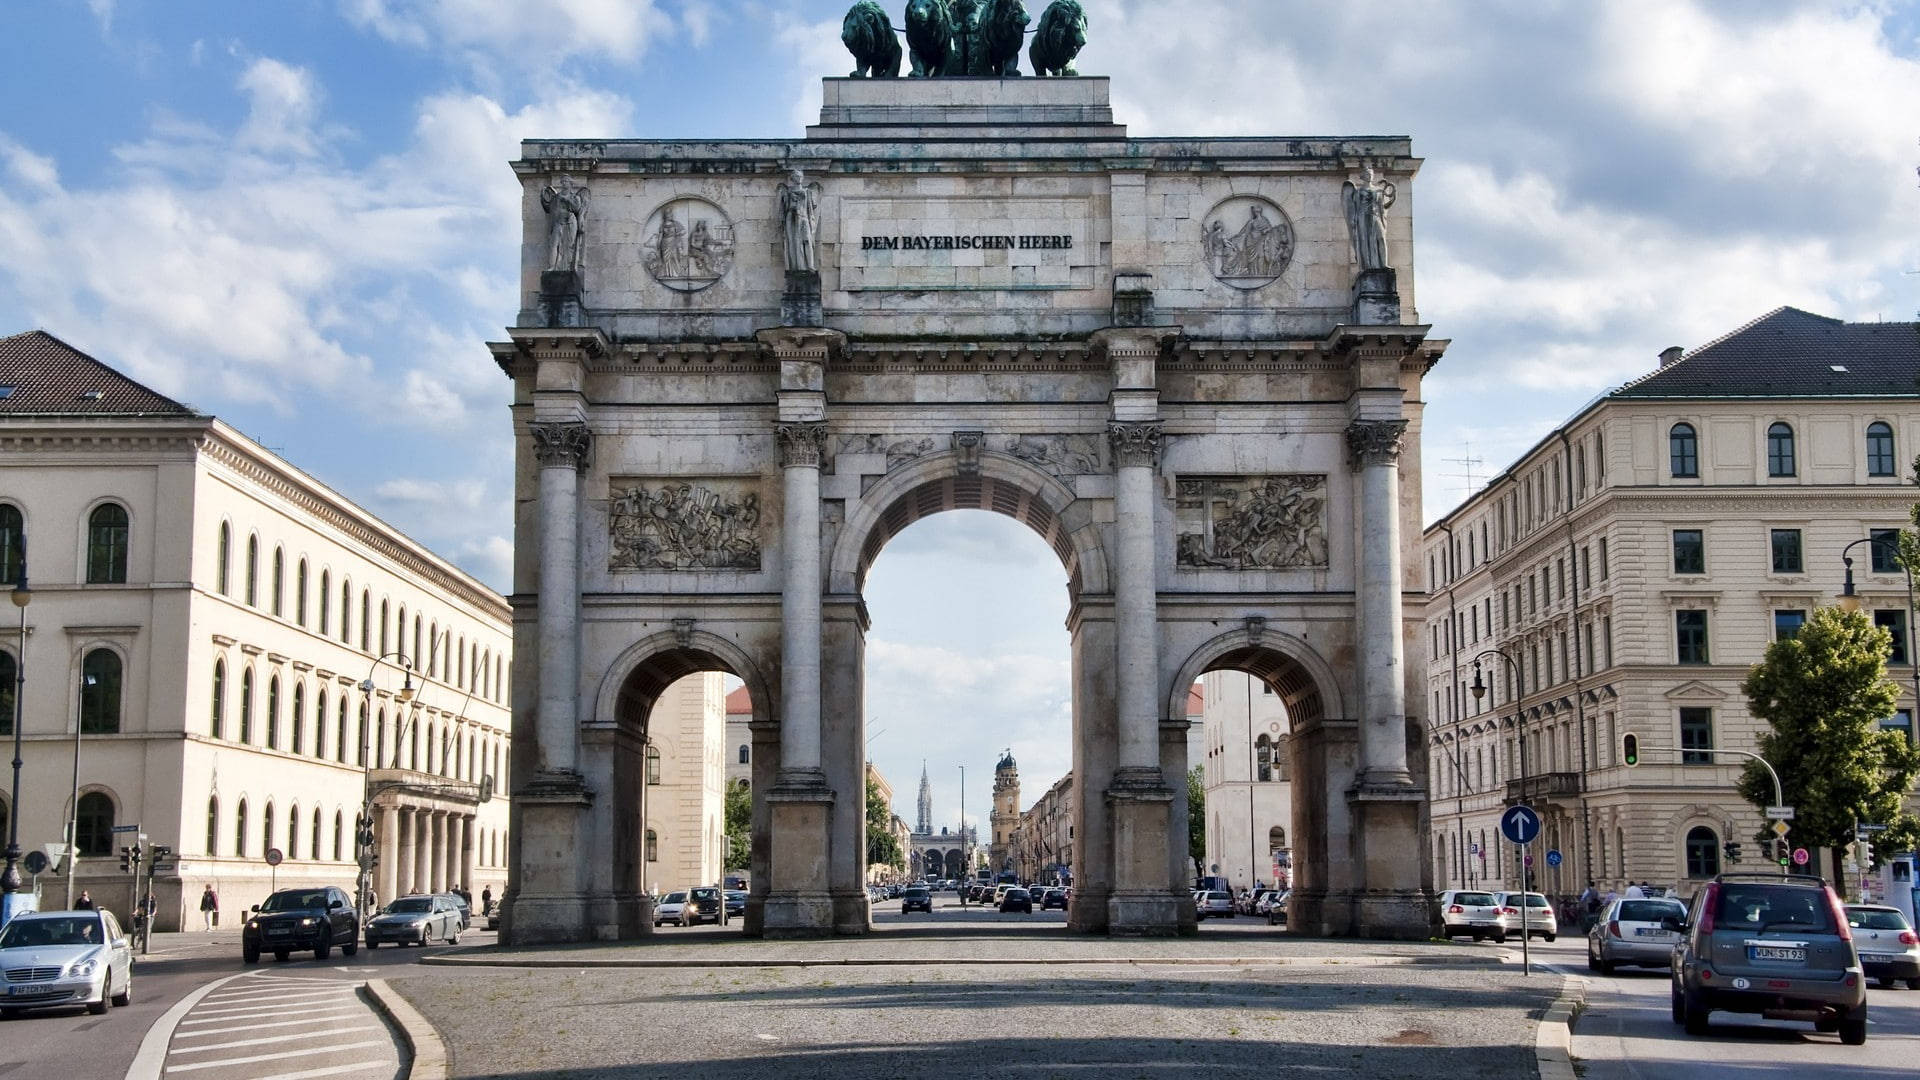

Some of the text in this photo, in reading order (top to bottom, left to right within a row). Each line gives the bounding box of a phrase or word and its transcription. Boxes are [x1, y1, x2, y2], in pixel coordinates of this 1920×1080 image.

[861, 235, 1072, 249] DEM BAYERISCHEN HEERE
[1778, 949, 1790, 958] ST
[1791, 950, 1803, 959] 93
